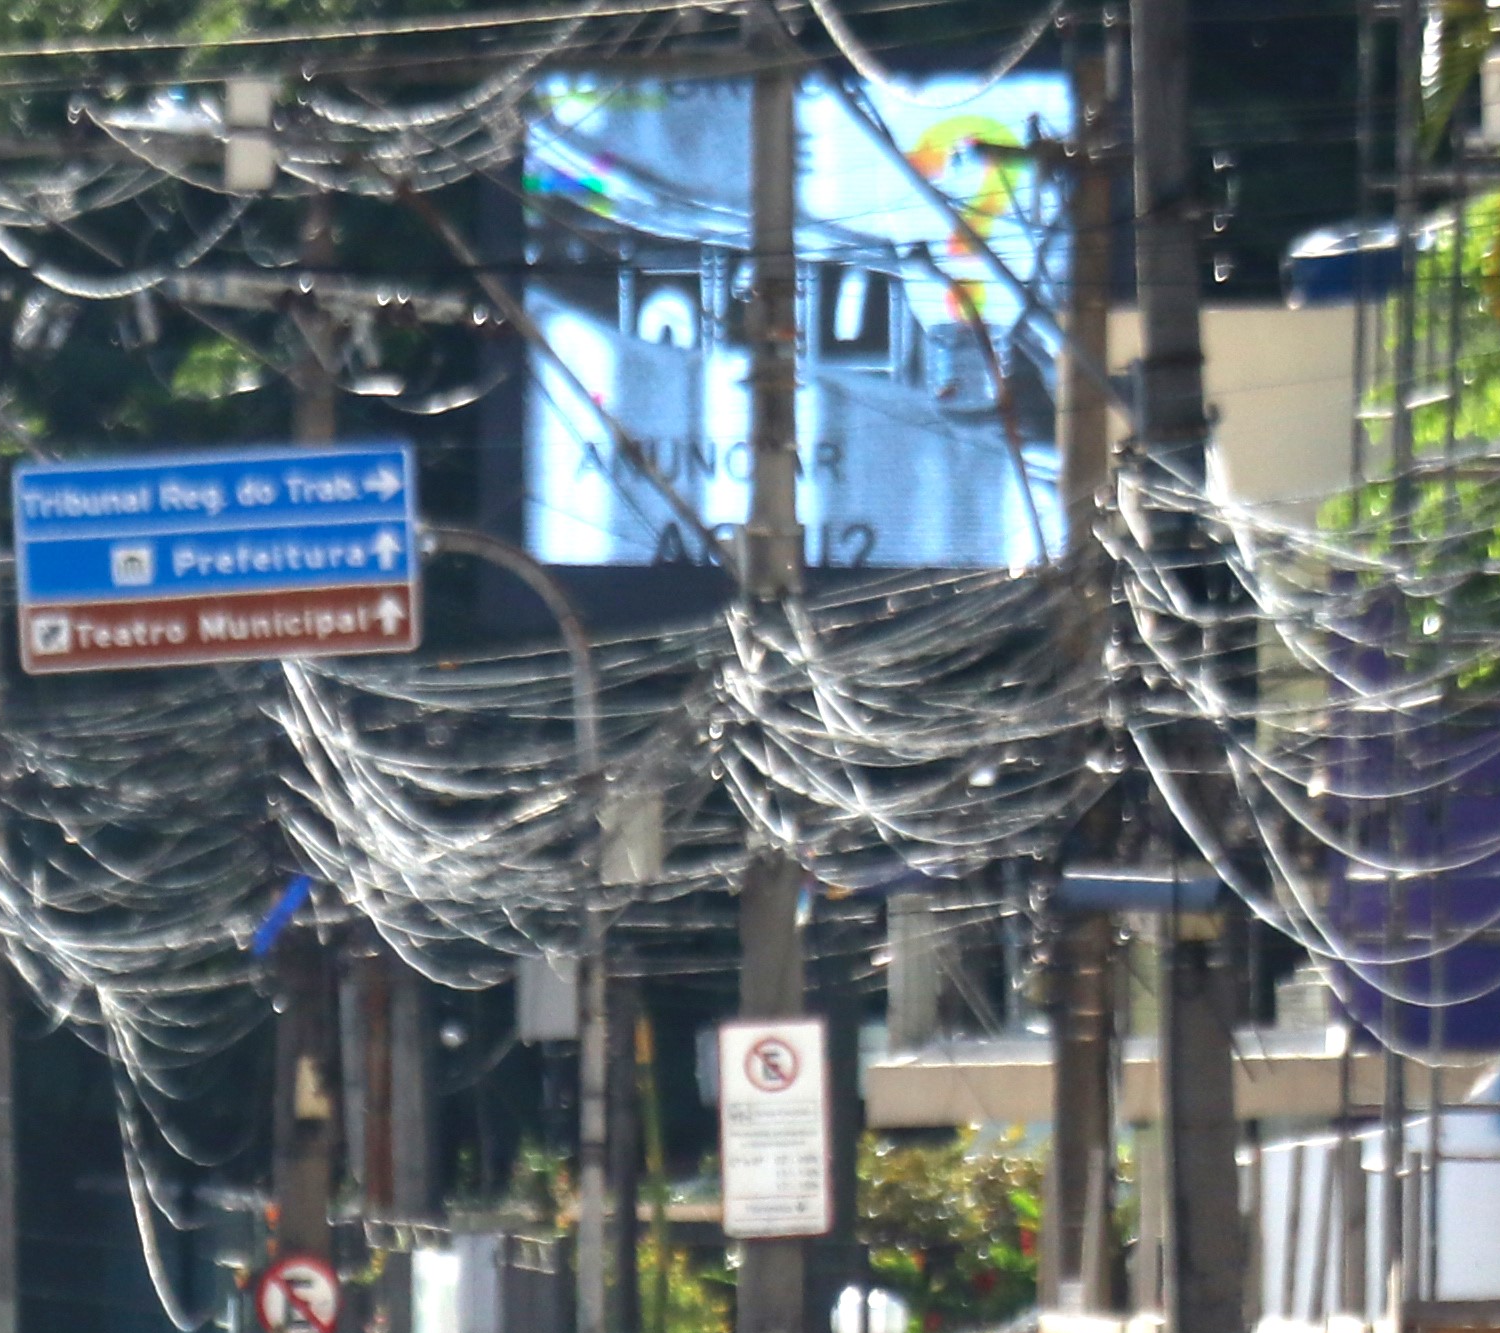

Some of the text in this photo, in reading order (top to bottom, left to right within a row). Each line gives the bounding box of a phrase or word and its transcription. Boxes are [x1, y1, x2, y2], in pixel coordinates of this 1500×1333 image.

[23, 472, 360, 518] Tribunal Reg. do Trab.
[172, 543, 366, 577] Prefeitura
[76, 605, 368, 648] Teatro Municipal
